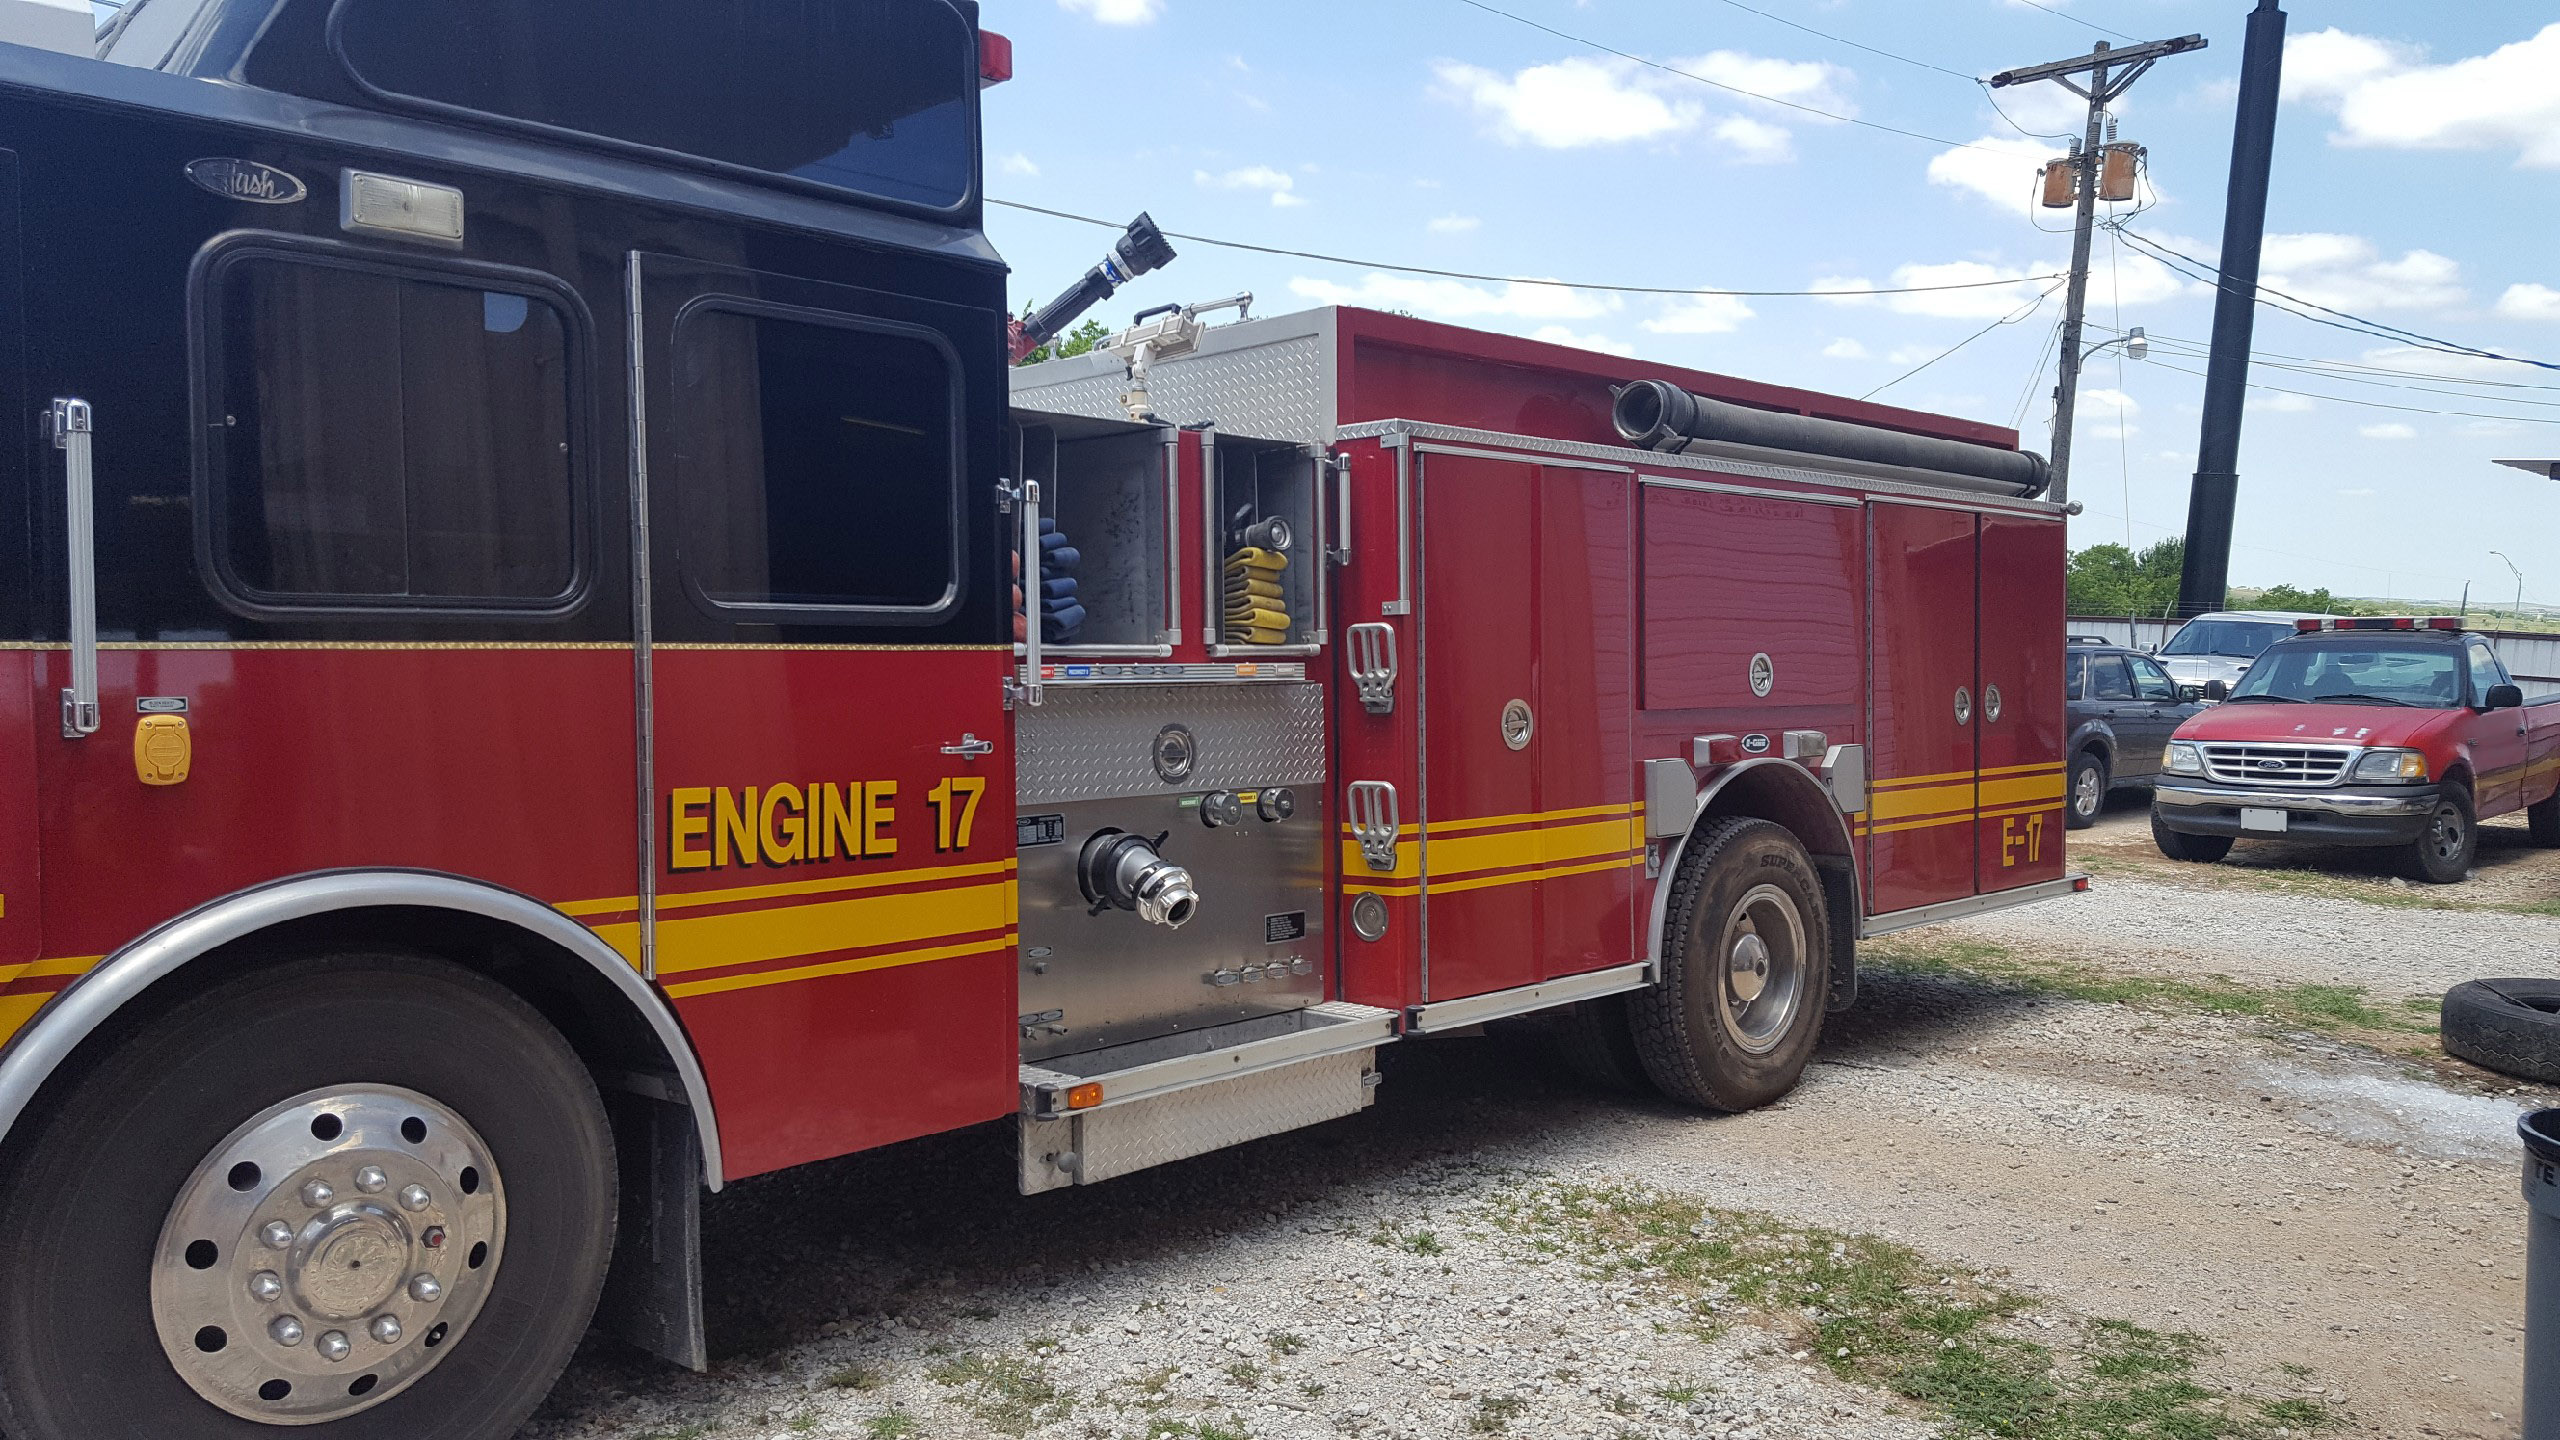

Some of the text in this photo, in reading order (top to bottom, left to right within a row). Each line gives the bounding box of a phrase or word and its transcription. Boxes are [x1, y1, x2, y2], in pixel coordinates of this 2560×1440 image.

[669, 776, 986, 870] ENGINE 17
[2002, 814, 2043, 867] E-17
